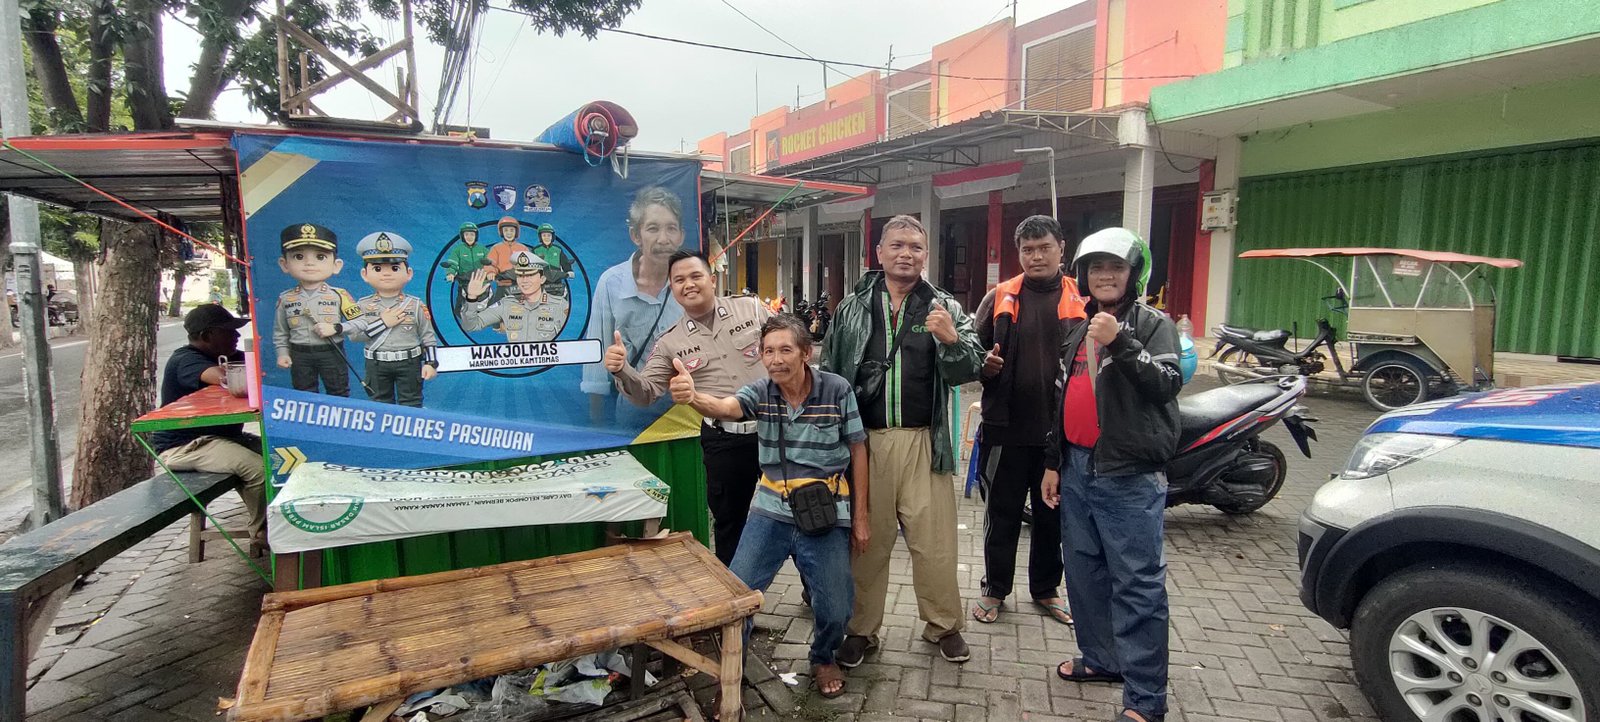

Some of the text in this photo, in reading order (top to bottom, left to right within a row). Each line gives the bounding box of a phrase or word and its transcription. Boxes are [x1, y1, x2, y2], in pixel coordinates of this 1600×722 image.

[781, 111, 866, 156] ROCKET CHICKEN
[729, 319, 755, 336] POLRI
[911, 324, 929, 333] Gra
[470, 343, 558, 360] WAKJOLMAS
[676, 345, 701, 358] VIAN
[469, 356, 560, 368] WARUNG OJOL KAMTIBMAS
[271, 398, 535, 452] SATLANTAS POLRES PASURUAN
[393, 503, 445, 511] KANAK-KANAK
[302, 523, 328, 531] ISLAM
[330, 512, 354, 529] DASAR
